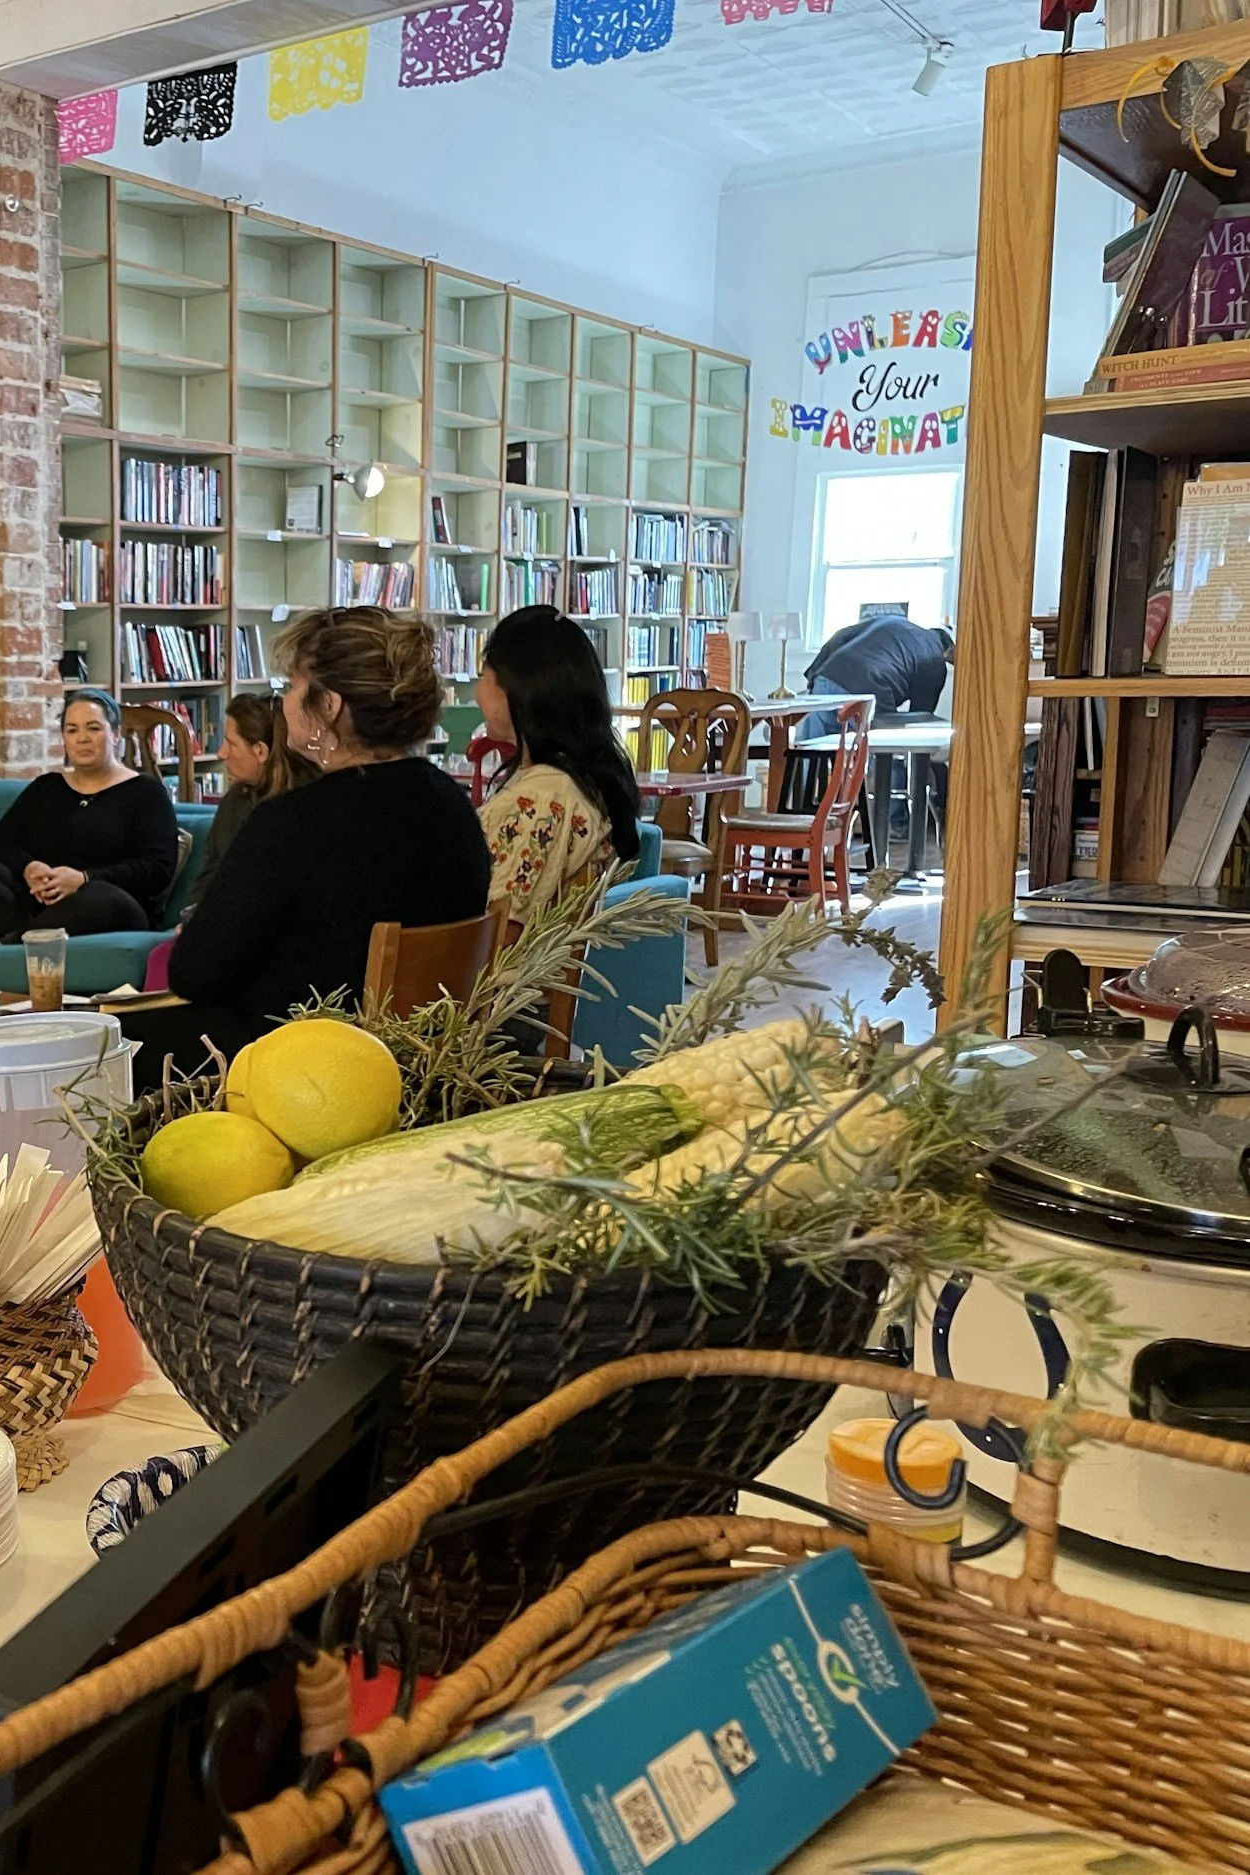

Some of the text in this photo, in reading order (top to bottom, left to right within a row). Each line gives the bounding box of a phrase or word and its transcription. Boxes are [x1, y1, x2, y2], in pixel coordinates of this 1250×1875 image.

[1102, 361, 1139, 374] WITCH
[1142, 355, 1178, 369] HUNT
[851, 361, 939, 412] Your
[1187, 485, 1211, 498] Why
[1216, 484, 1220, 494] I
[1223, 484, 1243, 494] Am
[1183, 625, 1223, 634] Feminist
[1208, 634, 1228, 642] then
[770, 1643, 837, 1763] spoons
